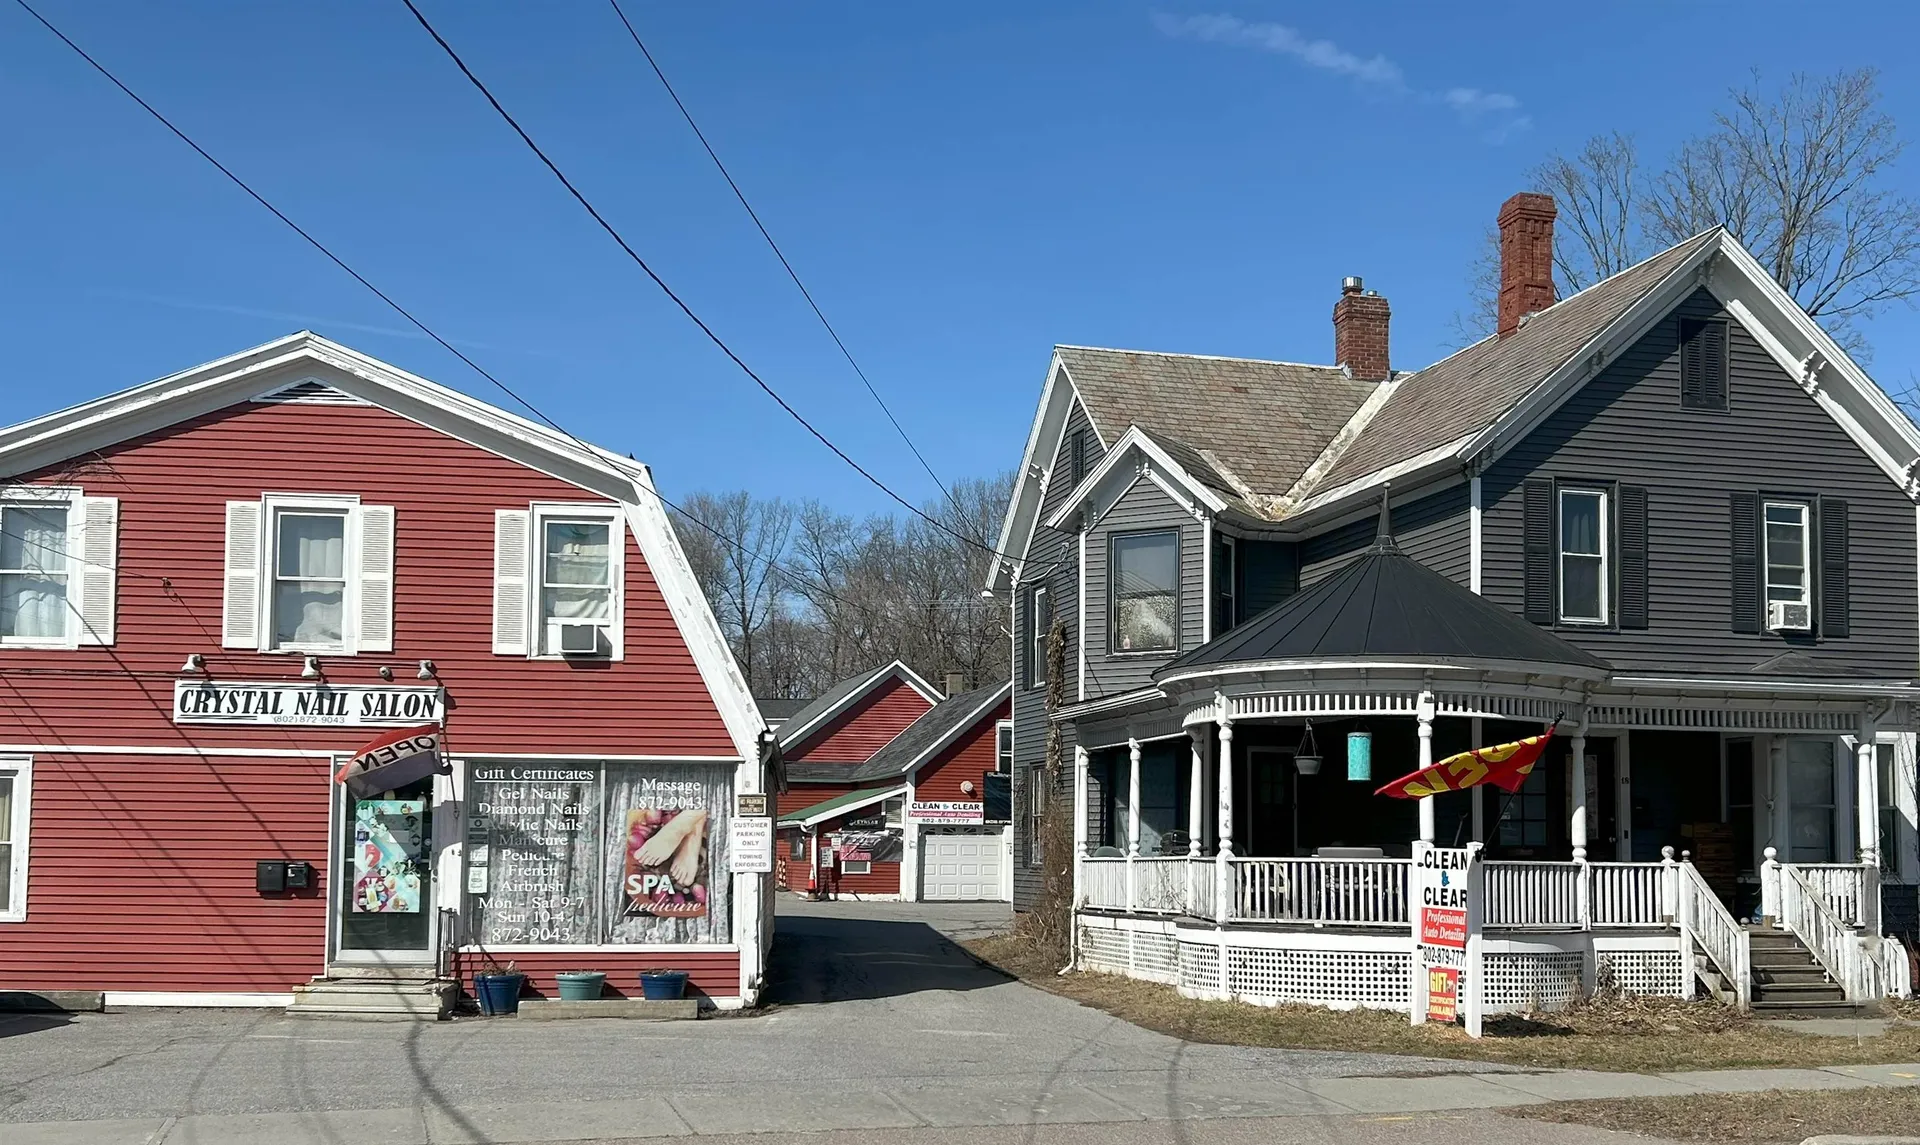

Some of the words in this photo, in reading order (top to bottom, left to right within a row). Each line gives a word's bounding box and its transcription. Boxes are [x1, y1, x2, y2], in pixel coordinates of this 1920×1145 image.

[179, 689, 284, 716] CRYSTAL
[294, 691, 349, 716] NAIL
[360, 693, 438, 719] SALON
[299, 715, 346, 725] 872-9043
[475, 766, 506, 780] Gift
[510, 766, 595, 780] Certificates
[641, 777, 701, 795] Massage
[499, 787, 526, 801] Gel
[532, 787, 570, 801] Nails
[478, 802, 545, 815] Diamond
[551, 802, 590, 815] Nails
[638, 795, 702, 810] 872-9043
[911, 802, 940, 810] CLEAN
[952, 803, 980, 811] CLEAR
[487, 819, 539, 834] Acrylic
[544, 818, 583, 831] Nails
[499, 834, 568, 846] Manicure
[501, 848, 565, 861] Pedicure
[1424, 850, 1468, 871] CLEAN
[508, 864, 559, 877] French
[500, 880, 564, 892] Airbrush
[626, 874, 676, 896] SPA
[1441, 870, 1450, 887] &
[478, 897, 513, 909] Mon
[531, 897, 557, 909] Sat
[560, 897, 585, 909] 9-7
[1423, 886, 1468, 908] CLEAR
[622, 894, 702, 916] pedicure
[497, 911, 526, 923] Sun
[533, 911, 565, 924] 10-4
[1426, 909, 1467, 926] Professional
[491, 927, 572, 942] 872-9043
[1424, 925, 1439, 938] Auto
[1439, 926, 1466, 942] Detailin
[1430, 971, 1448, 993] GIFT
